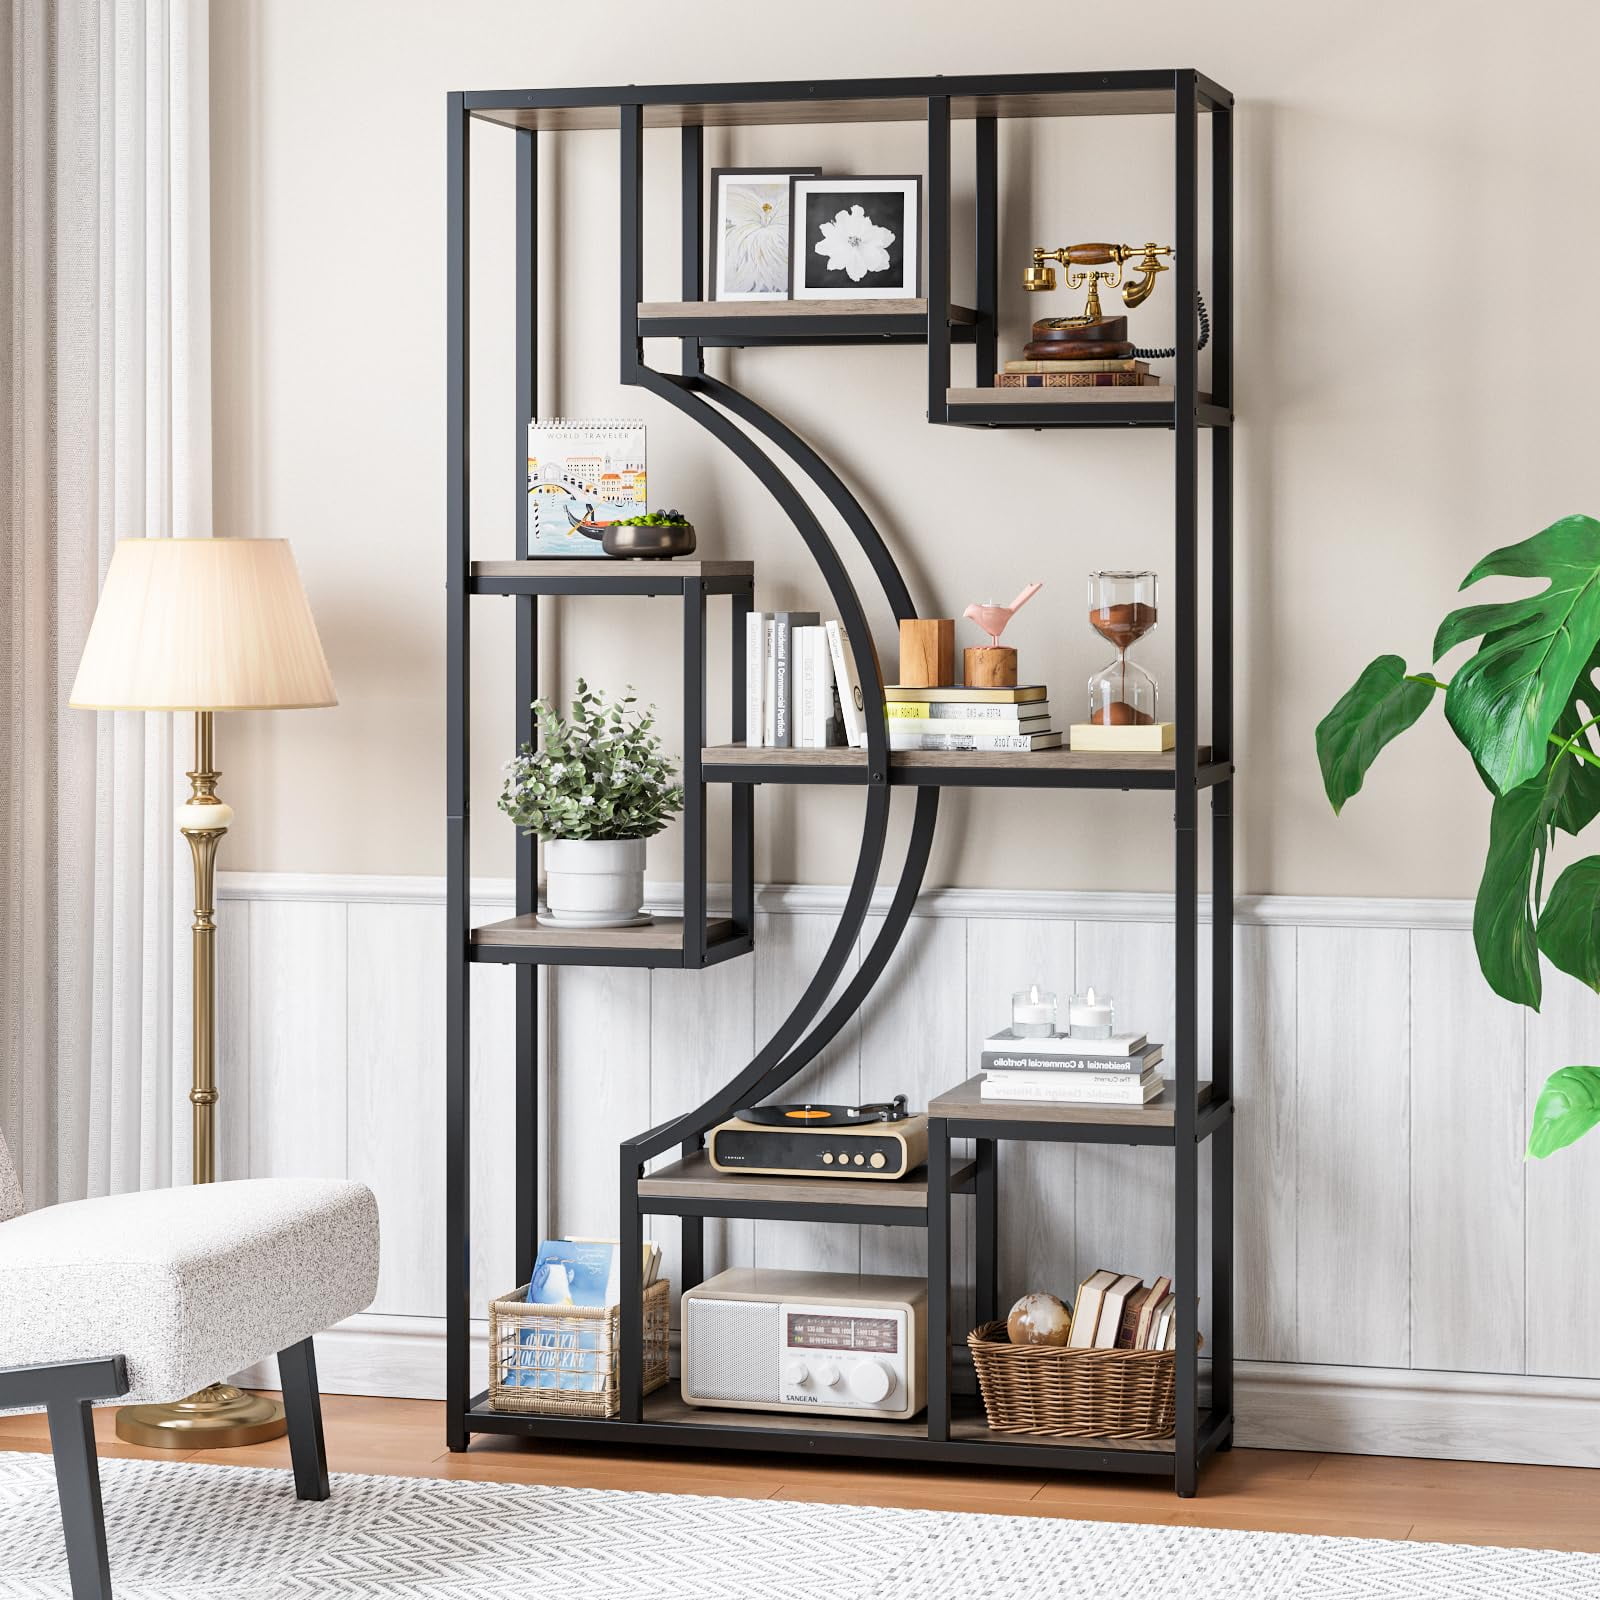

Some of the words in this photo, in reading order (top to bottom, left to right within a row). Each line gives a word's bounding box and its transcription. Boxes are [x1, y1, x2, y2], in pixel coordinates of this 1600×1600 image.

[777, 623, 786, 659] Residential
[777, 668, 786, 708] Commercial
[777, 709, 786, 737] Portfolio
[786, 1395, 818, 1403] SANGEAN
